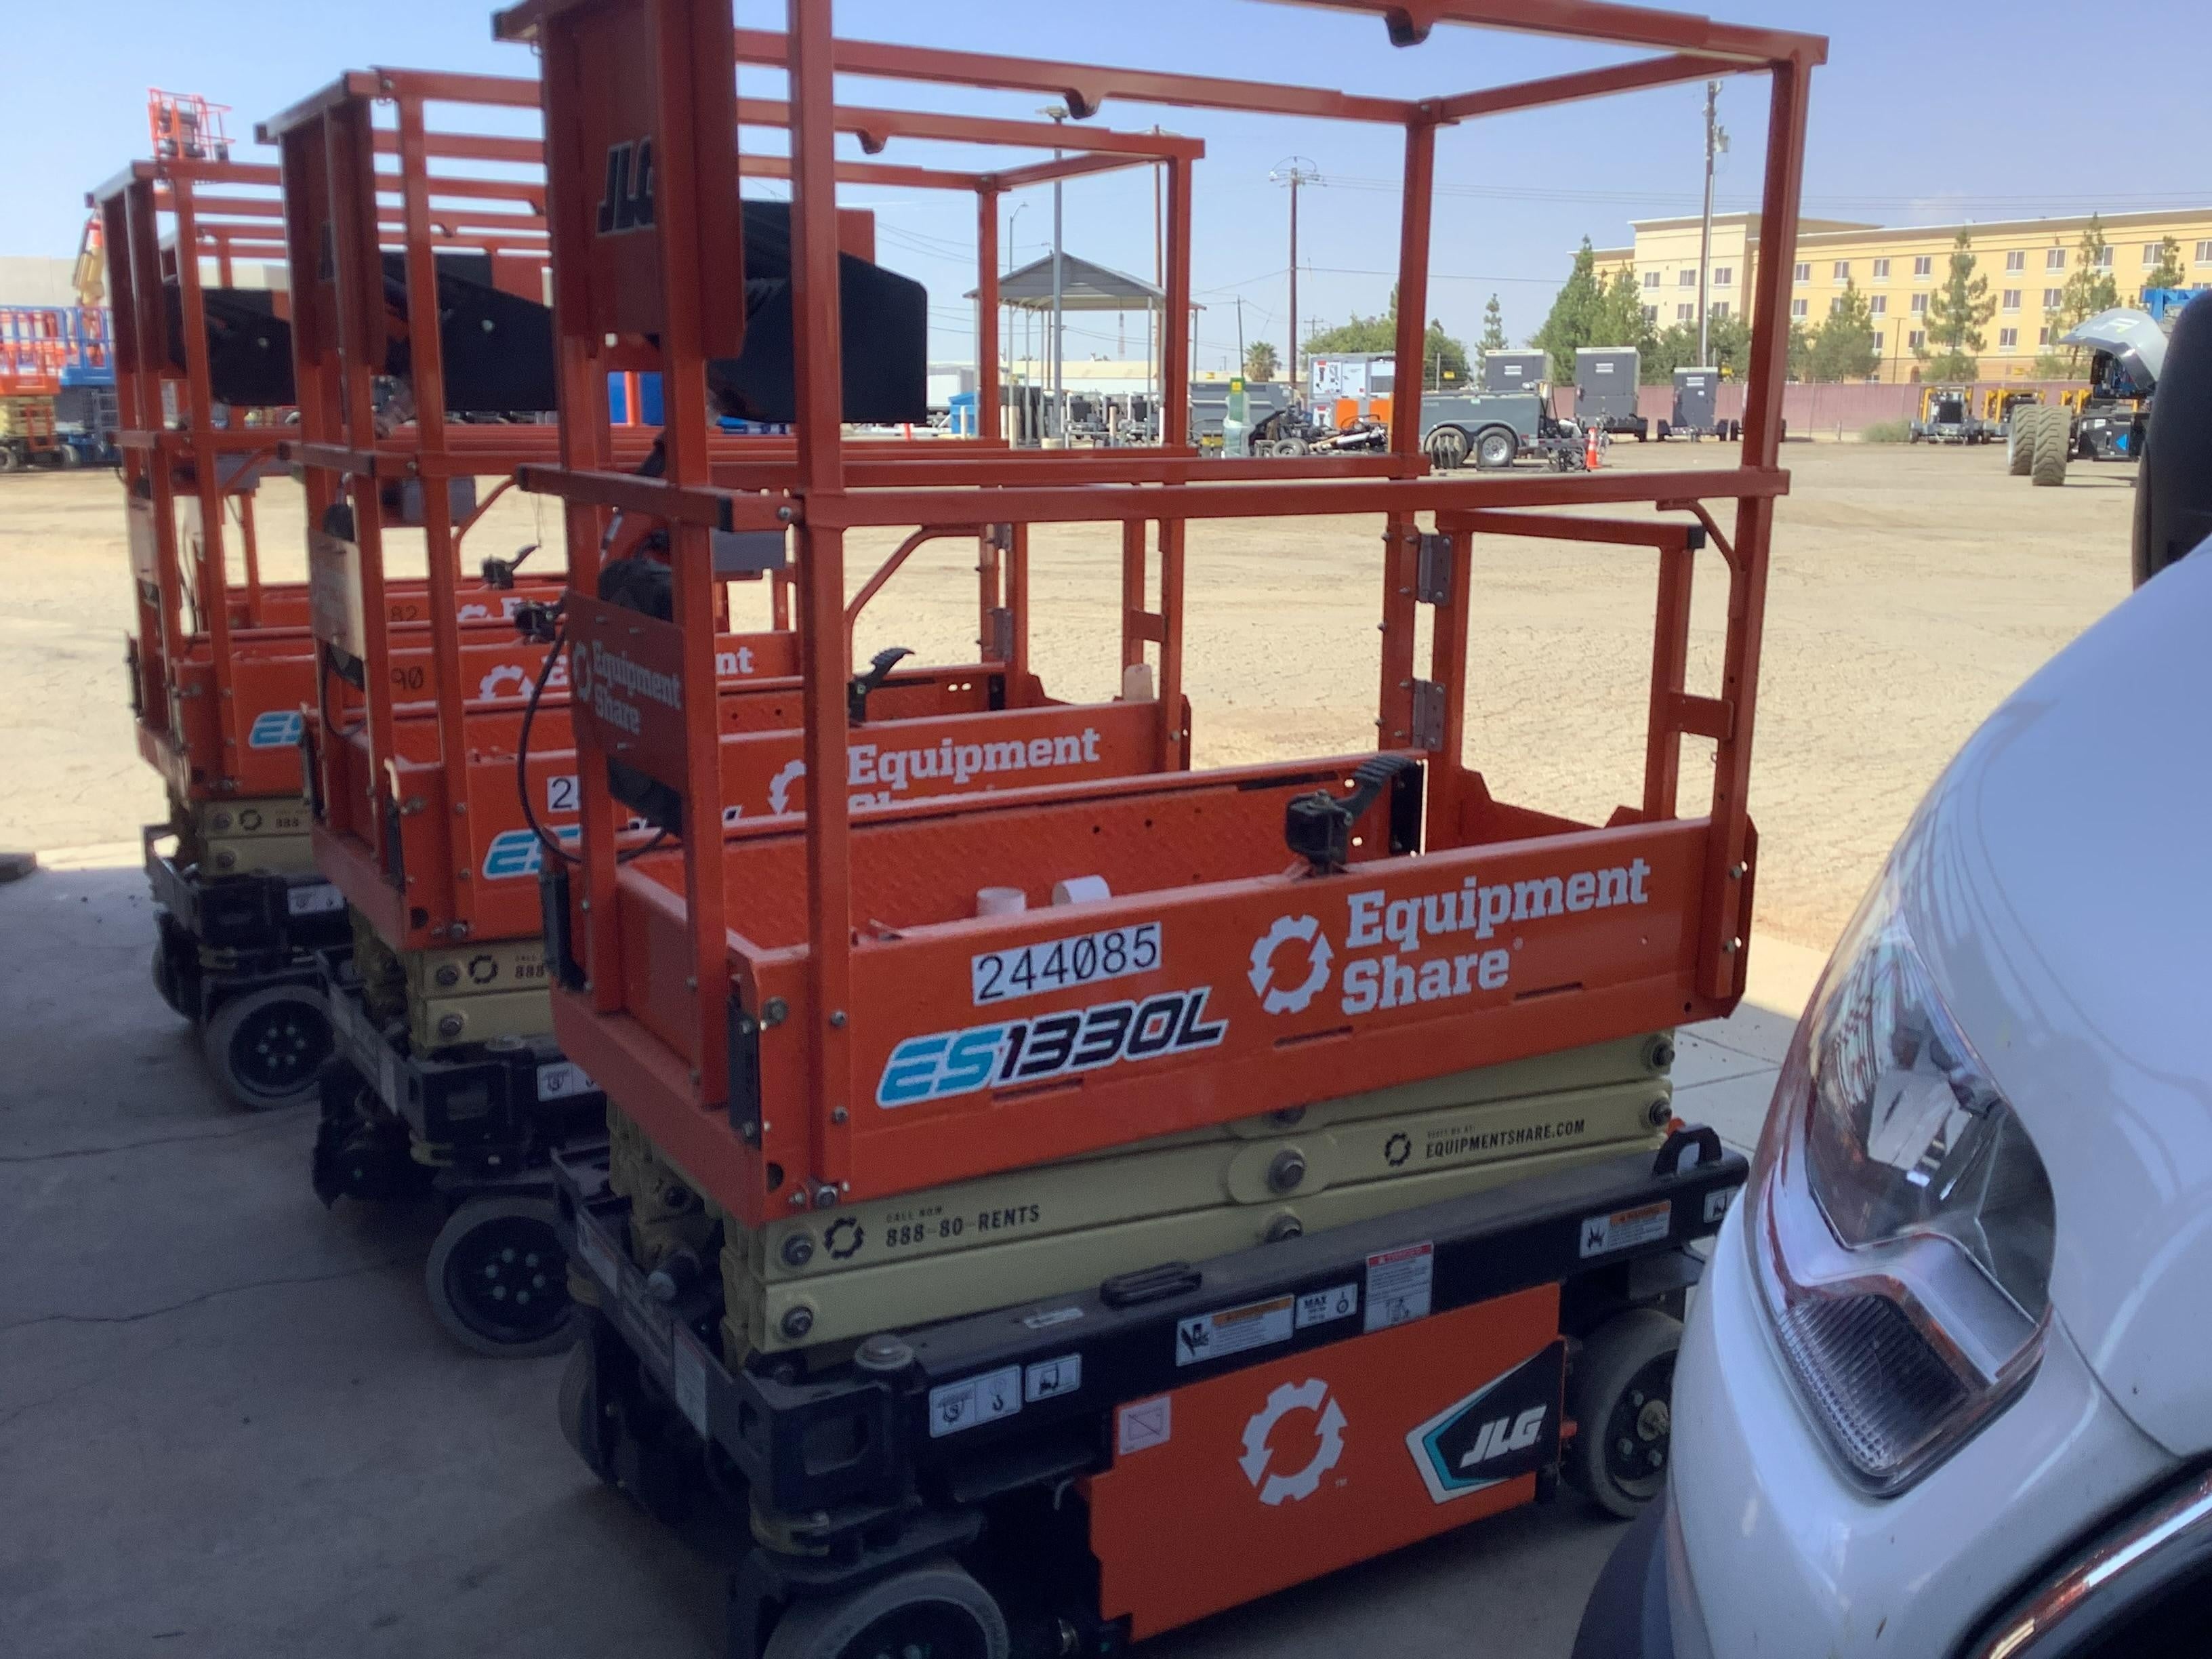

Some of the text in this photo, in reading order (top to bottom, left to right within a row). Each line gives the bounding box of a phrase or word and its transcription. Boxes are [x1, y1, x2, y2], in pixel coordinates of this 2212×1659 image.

[592, 640, 682, 711] Equipment
[594, 682, 641, 736] Share
[847, 727, 1101, 791] Equipment
[1345, 857, 1651, 952] Equipment
[977, 925, 1158, 1000] 244085
[1341, 948, 1511, 1016] Share
[877, 987, 1229, 1107] ES1330L
[1426, 1119, 1585, 1159] EQUIPMENTSHARE.COM
[1460, 1405, 1547, 1469] JLG
